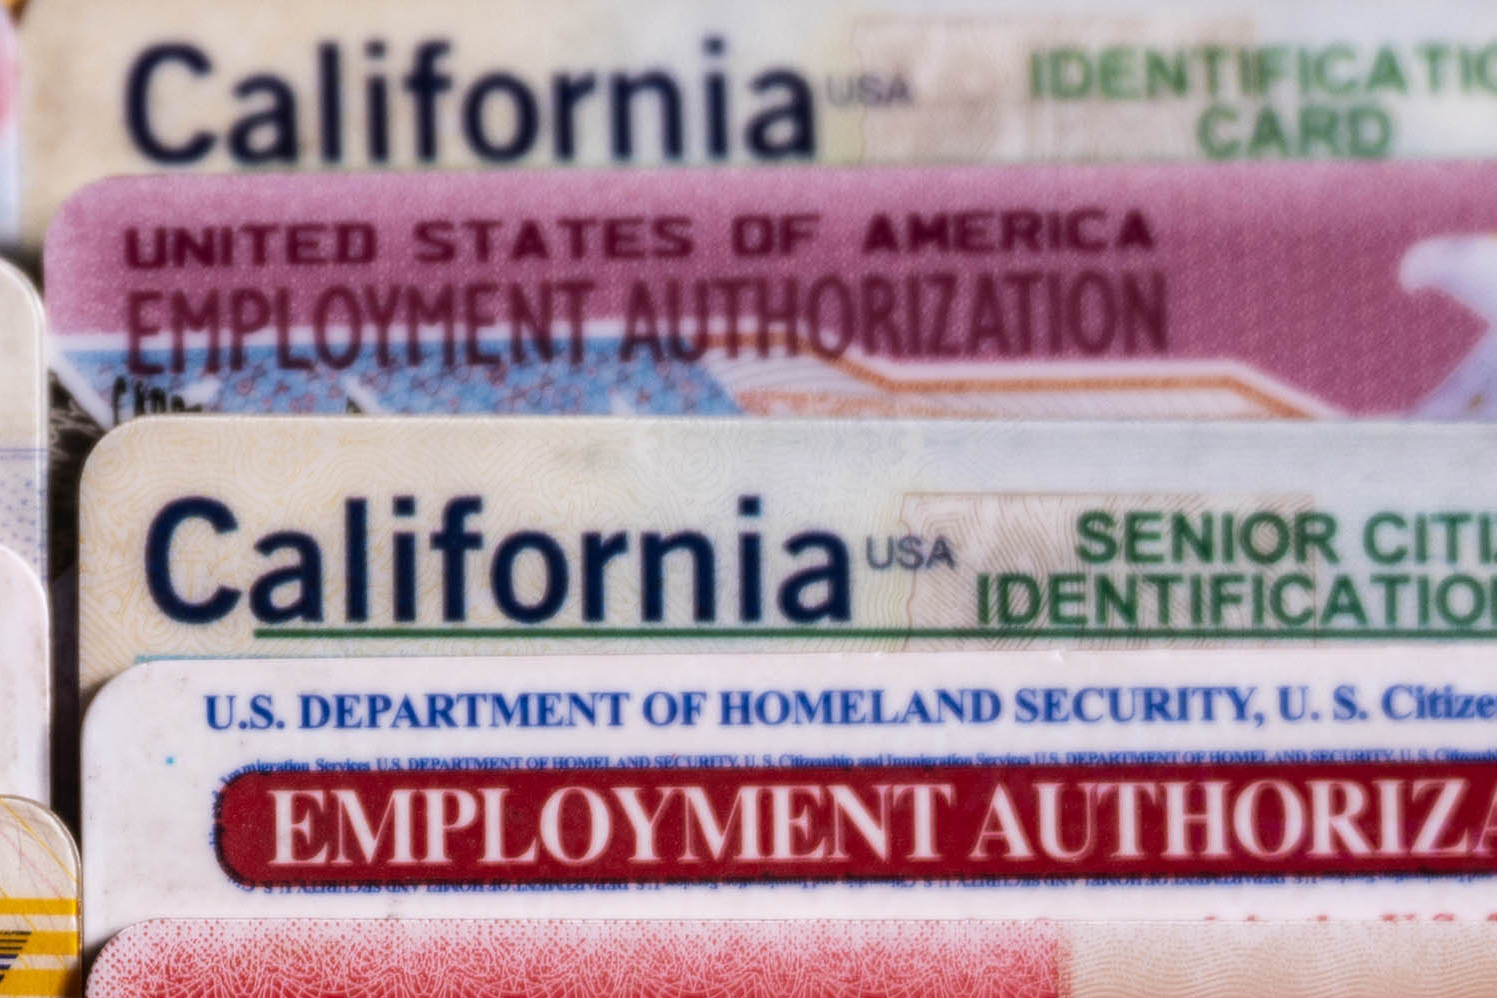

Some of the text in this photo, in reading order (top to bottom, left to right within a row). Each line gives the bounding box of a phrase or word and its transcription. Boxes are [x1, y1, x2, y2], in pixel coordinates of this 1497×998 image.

[124, 37, 912, 166] California USA
[1196, 104, 1393, 159] CARD
[123, 208, 1156, 270] UNITED STATES OF AMERICA
[125, 269, 1168, 377] EMPLOYMENT AUTHORIZATION
[144, 495, 956, 625] California USA
[1076, 510, 1497, 566] SENIOR CITI
[976, 571, 1497, 628] IDENTIFICATIO
[204, 692, 284, 731] U.S.
[298, 691, 630, 730] DEPARTMENT
[643, 690, 707, 727] OF
[719, 686, 1002, 726] HOMELAND
[1014, 686, 1266, 734] SECURITY,
[1278, 686, 1321, 722] U.
[1333, 685, 1369, 721] S.
[268, 782, 955, 865] EMPLOYMENT
